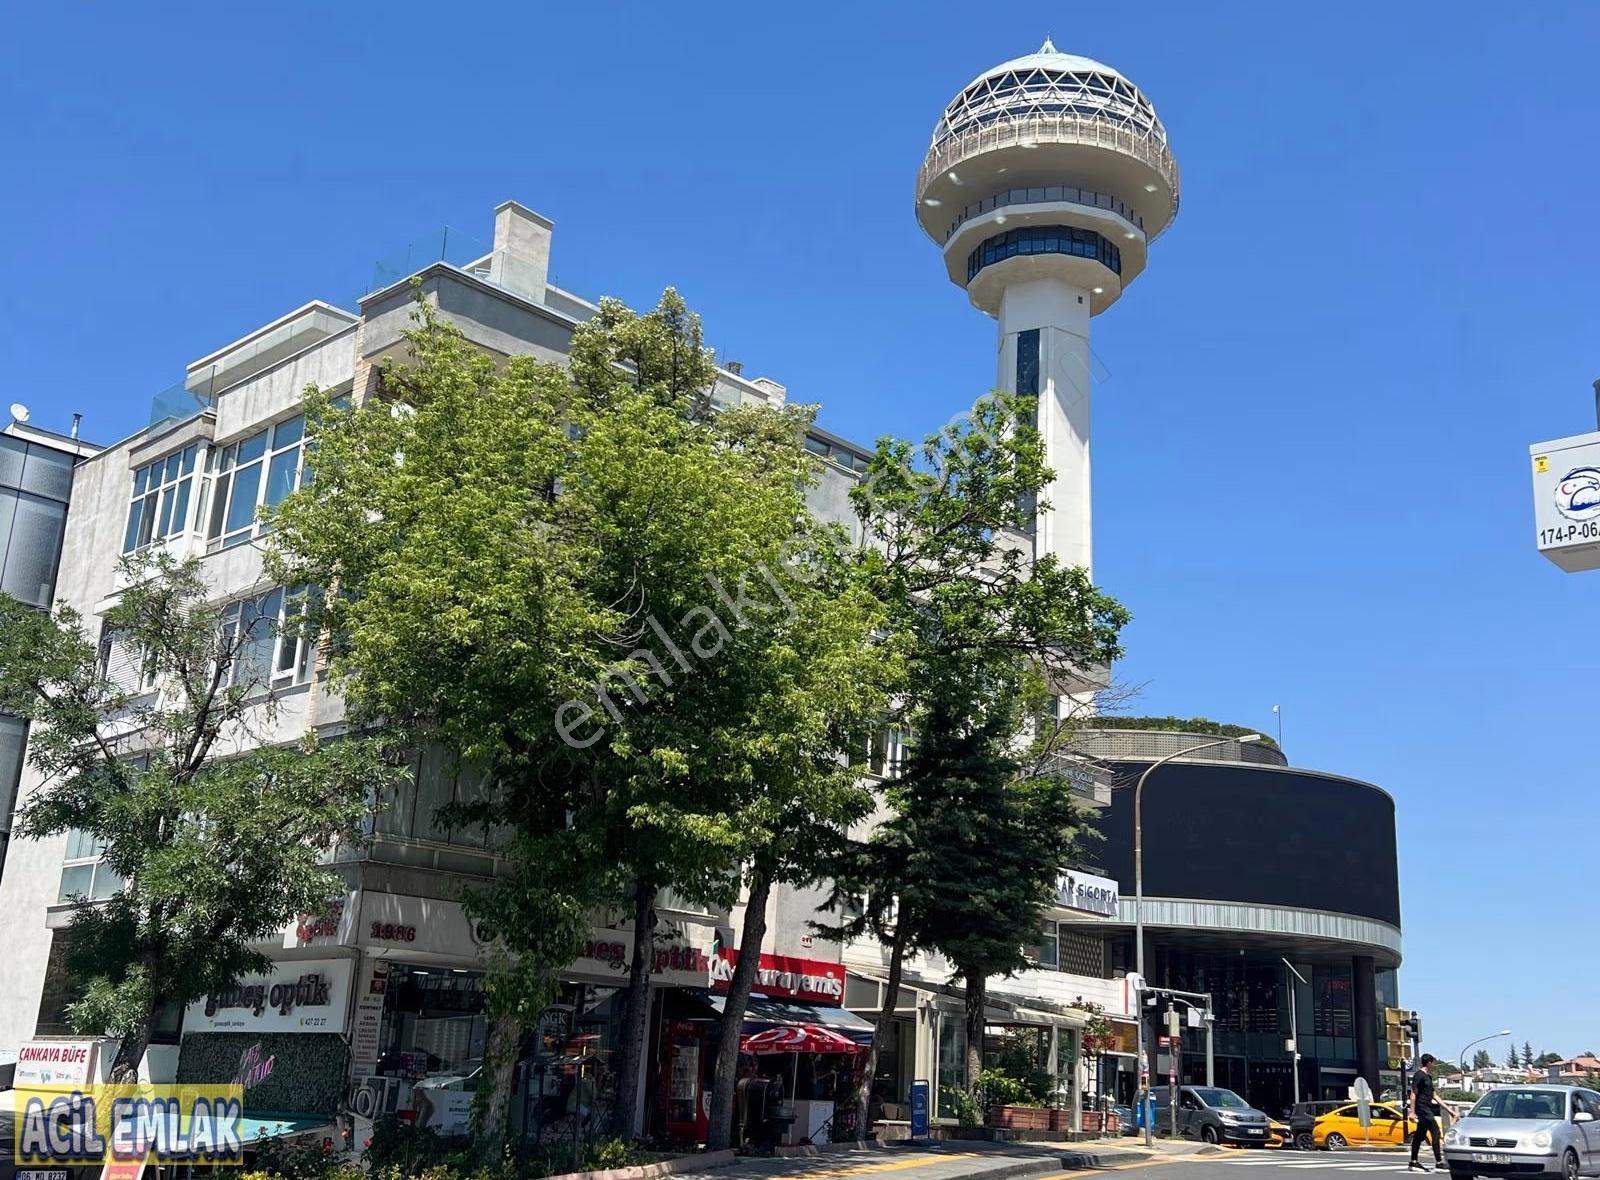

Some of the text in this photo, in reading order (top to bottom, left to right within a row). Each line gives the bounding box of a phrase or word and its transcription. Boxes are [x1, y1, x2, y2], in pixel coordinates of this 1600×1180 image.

[1077, 882, 1118, 904] SİGORTA
[371, 921, 416, 942] 1986
[652, 946, 710, 975] ptik
[269, 974, 330, 1016] optik
[543, 1012, 568, 1025] SGK
[19, 1045, 87, 1064] ÇANKAYA BÜFE
